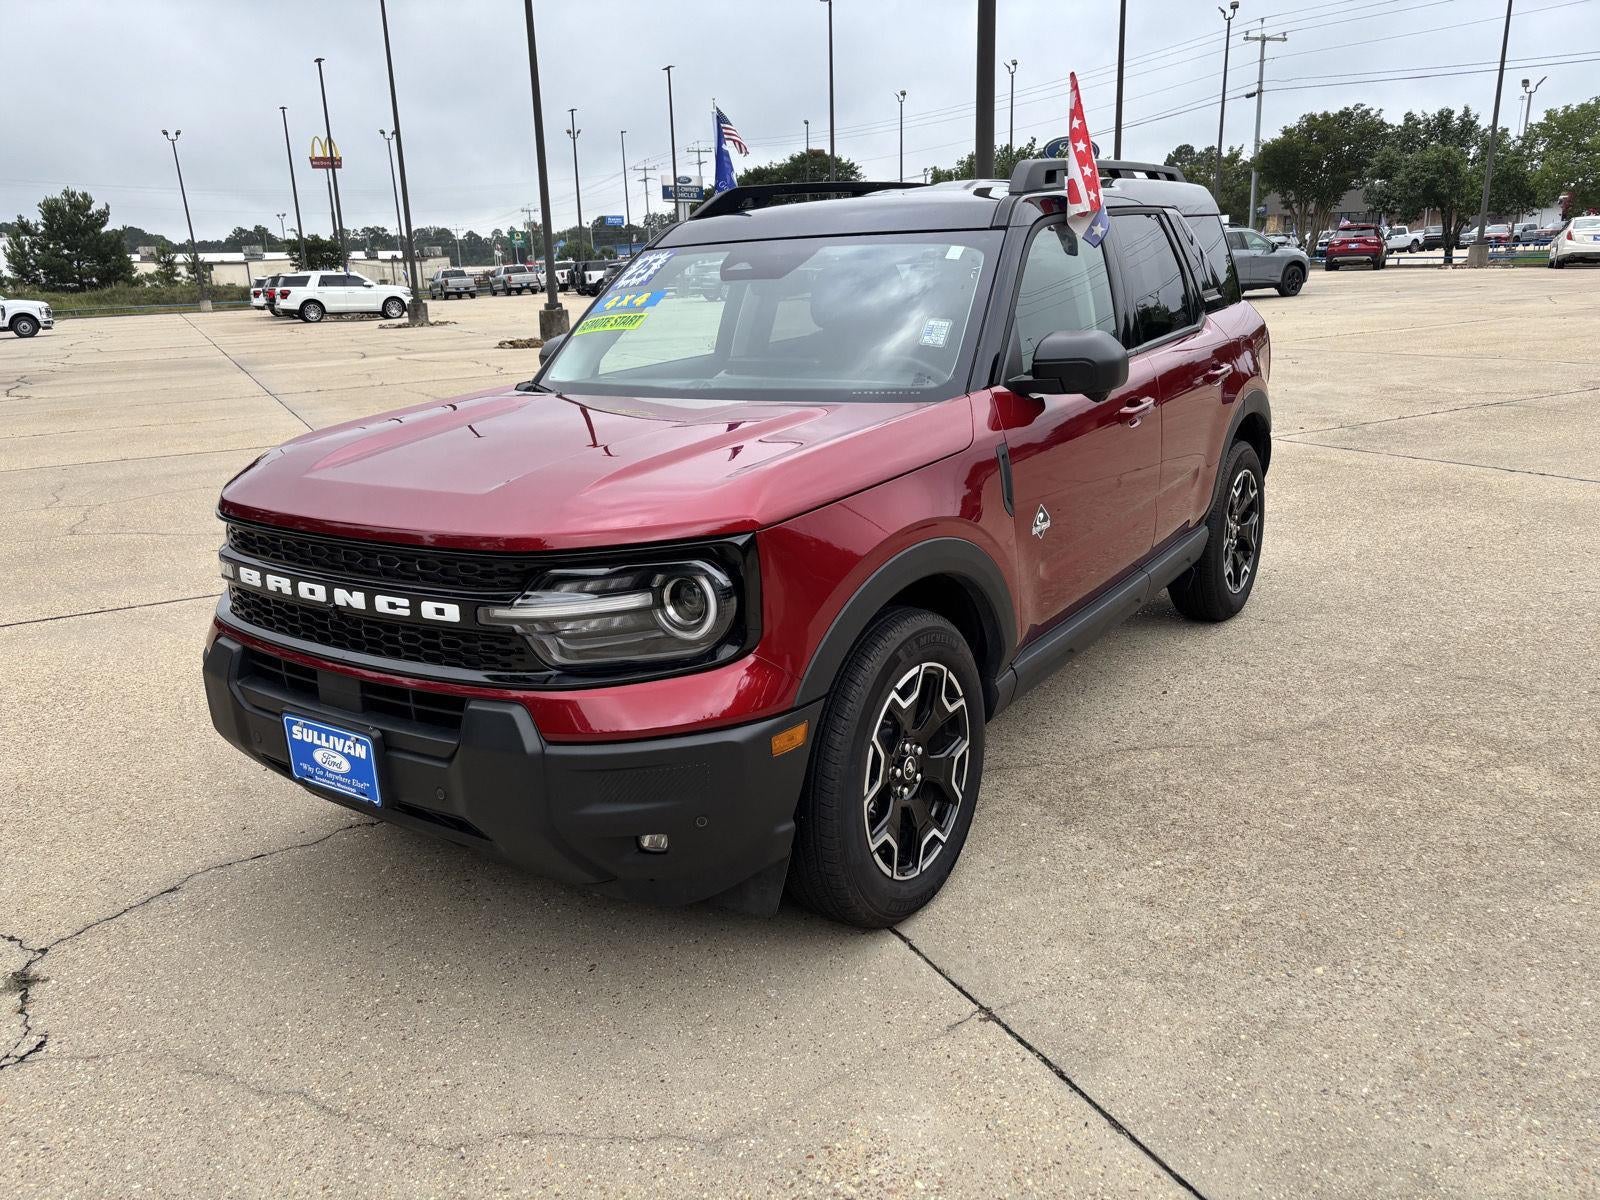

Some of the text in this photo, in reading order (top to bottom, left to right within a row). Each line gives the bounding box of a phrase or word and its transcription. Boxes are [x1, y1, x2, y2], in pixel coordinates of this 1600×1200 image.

[609, 314, 645, 328] START
[239, 566, 461, 623] BRONCO
[919, 631, 959, 649] MICHELIN
[291, 724, 367, 760] SULLIVAN
[320, 751, 343, 770] Ford
[315, 767, 324, 775] Go
[325, 771, 352, 785] Anywhere
